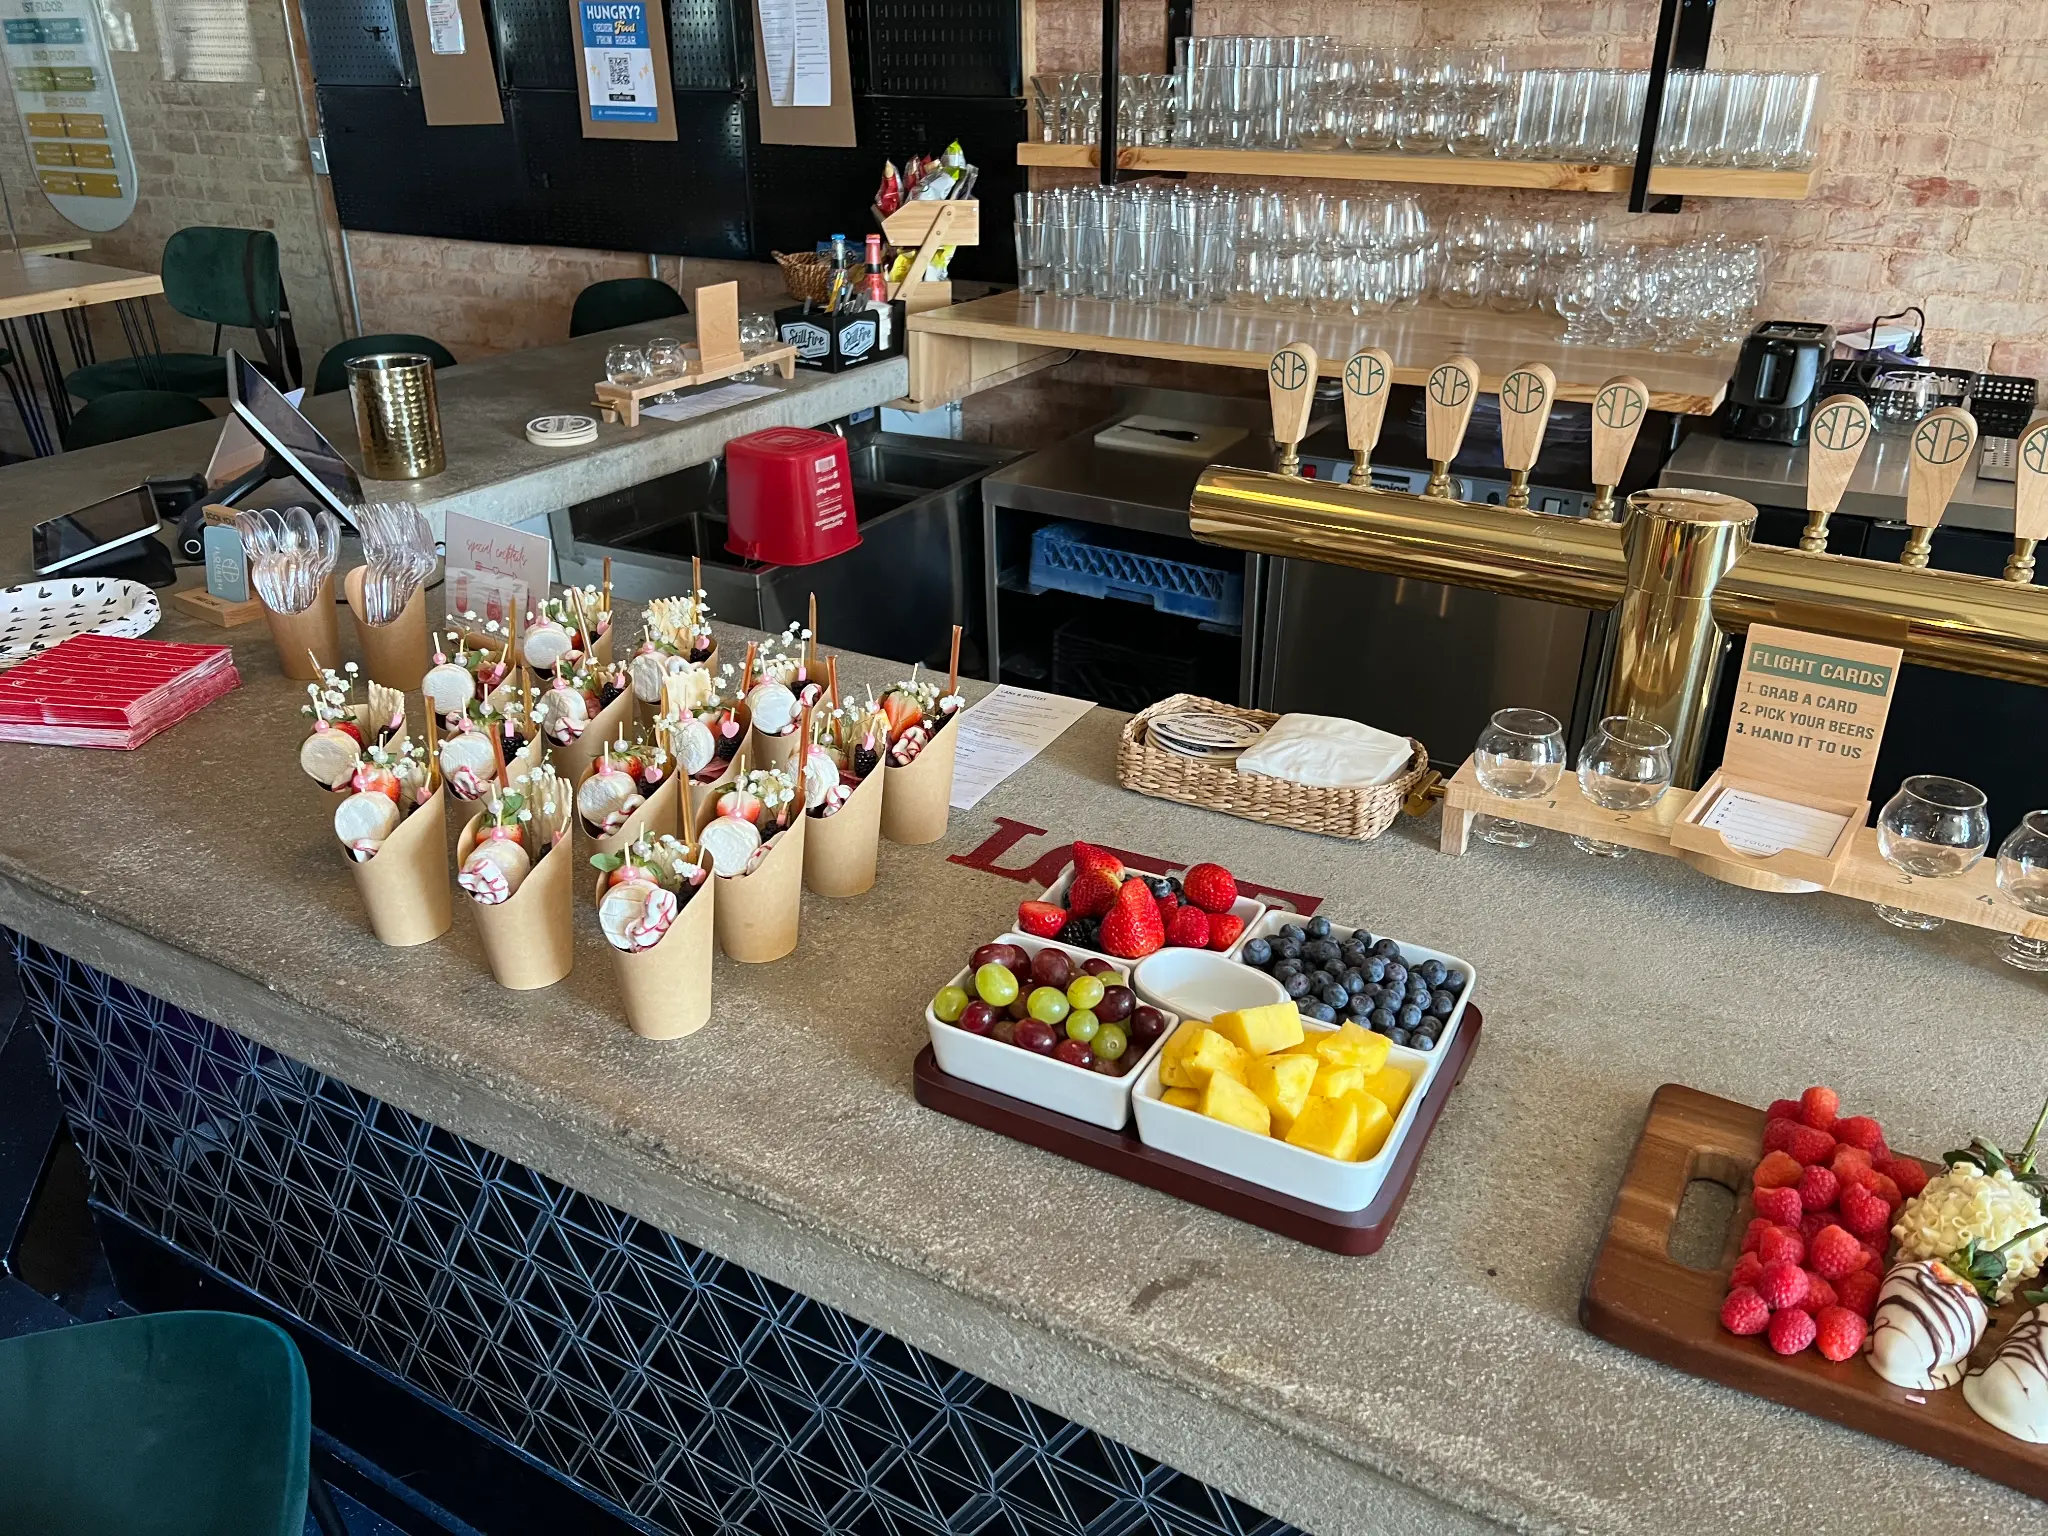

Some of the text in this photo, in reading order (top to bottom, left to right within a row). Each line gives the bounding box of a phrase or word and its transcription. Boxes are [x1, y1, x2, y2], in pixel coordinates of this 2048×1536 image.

[586, 4, 641, 20] HUNGRY?
[614, 19, 636, 35] Food
[466, 539, 527, 568] special cocktails
[1752, 650, 1885, 689] FLIGHT CARDS
[1746, 681, 1858, 715] 1. GRAB A CARD
[1739, 701, 1875, 740] 2. PICK YOUR BEERS
[1735, 722, 1862, 760] 3. HAND IT TO US
[1615, 813, 1632, 824] 2
[1743, 839, 1772, 849] YOUR
[1896, 873, 1913, 885] 3
[1976, 894, 1996, 906] 4
